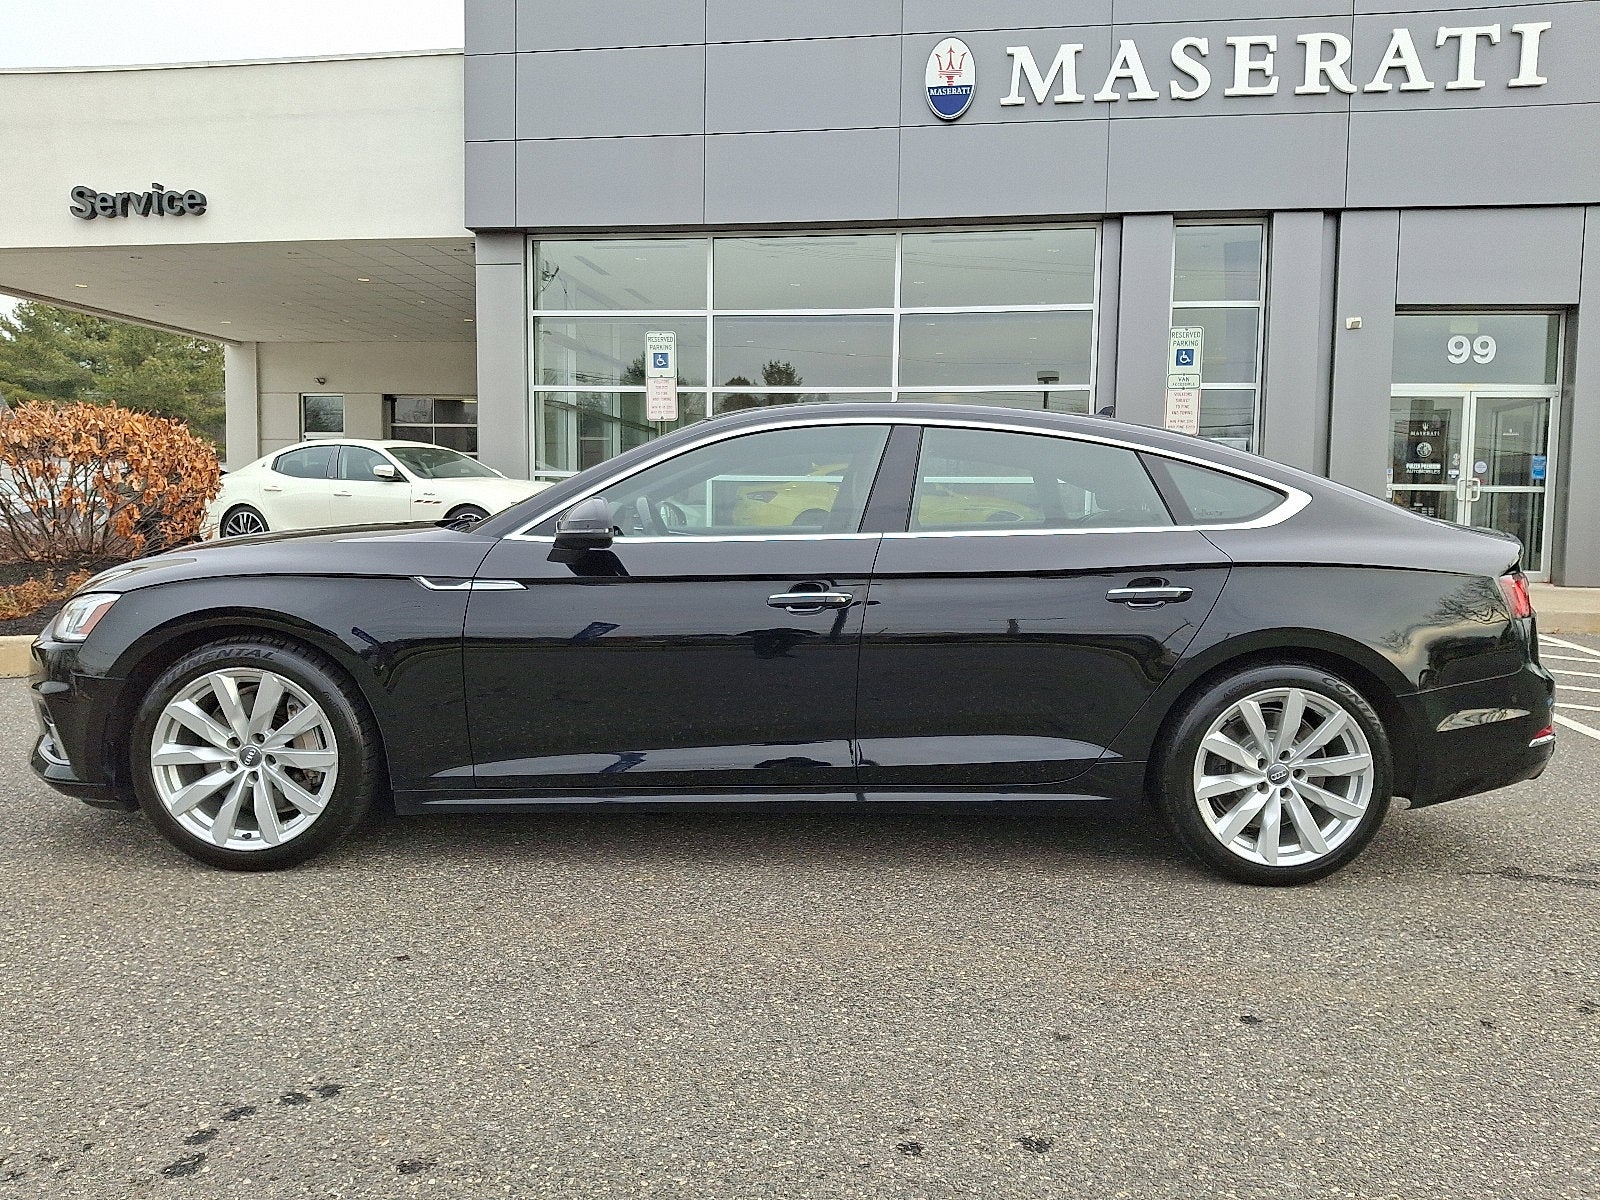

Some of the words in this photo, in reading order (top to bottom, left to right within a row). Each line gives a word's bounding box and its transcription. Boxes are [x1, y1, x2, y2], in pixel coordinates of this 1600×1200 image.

[1000, 21, 1552, 106] MASERATI
[929, 87, 971, 96] MASERATI
[70, 182, 207, 220] Service
[1171, 331, 1200, 339] RESERVED
[1446, 335, 1497, 364] 99
